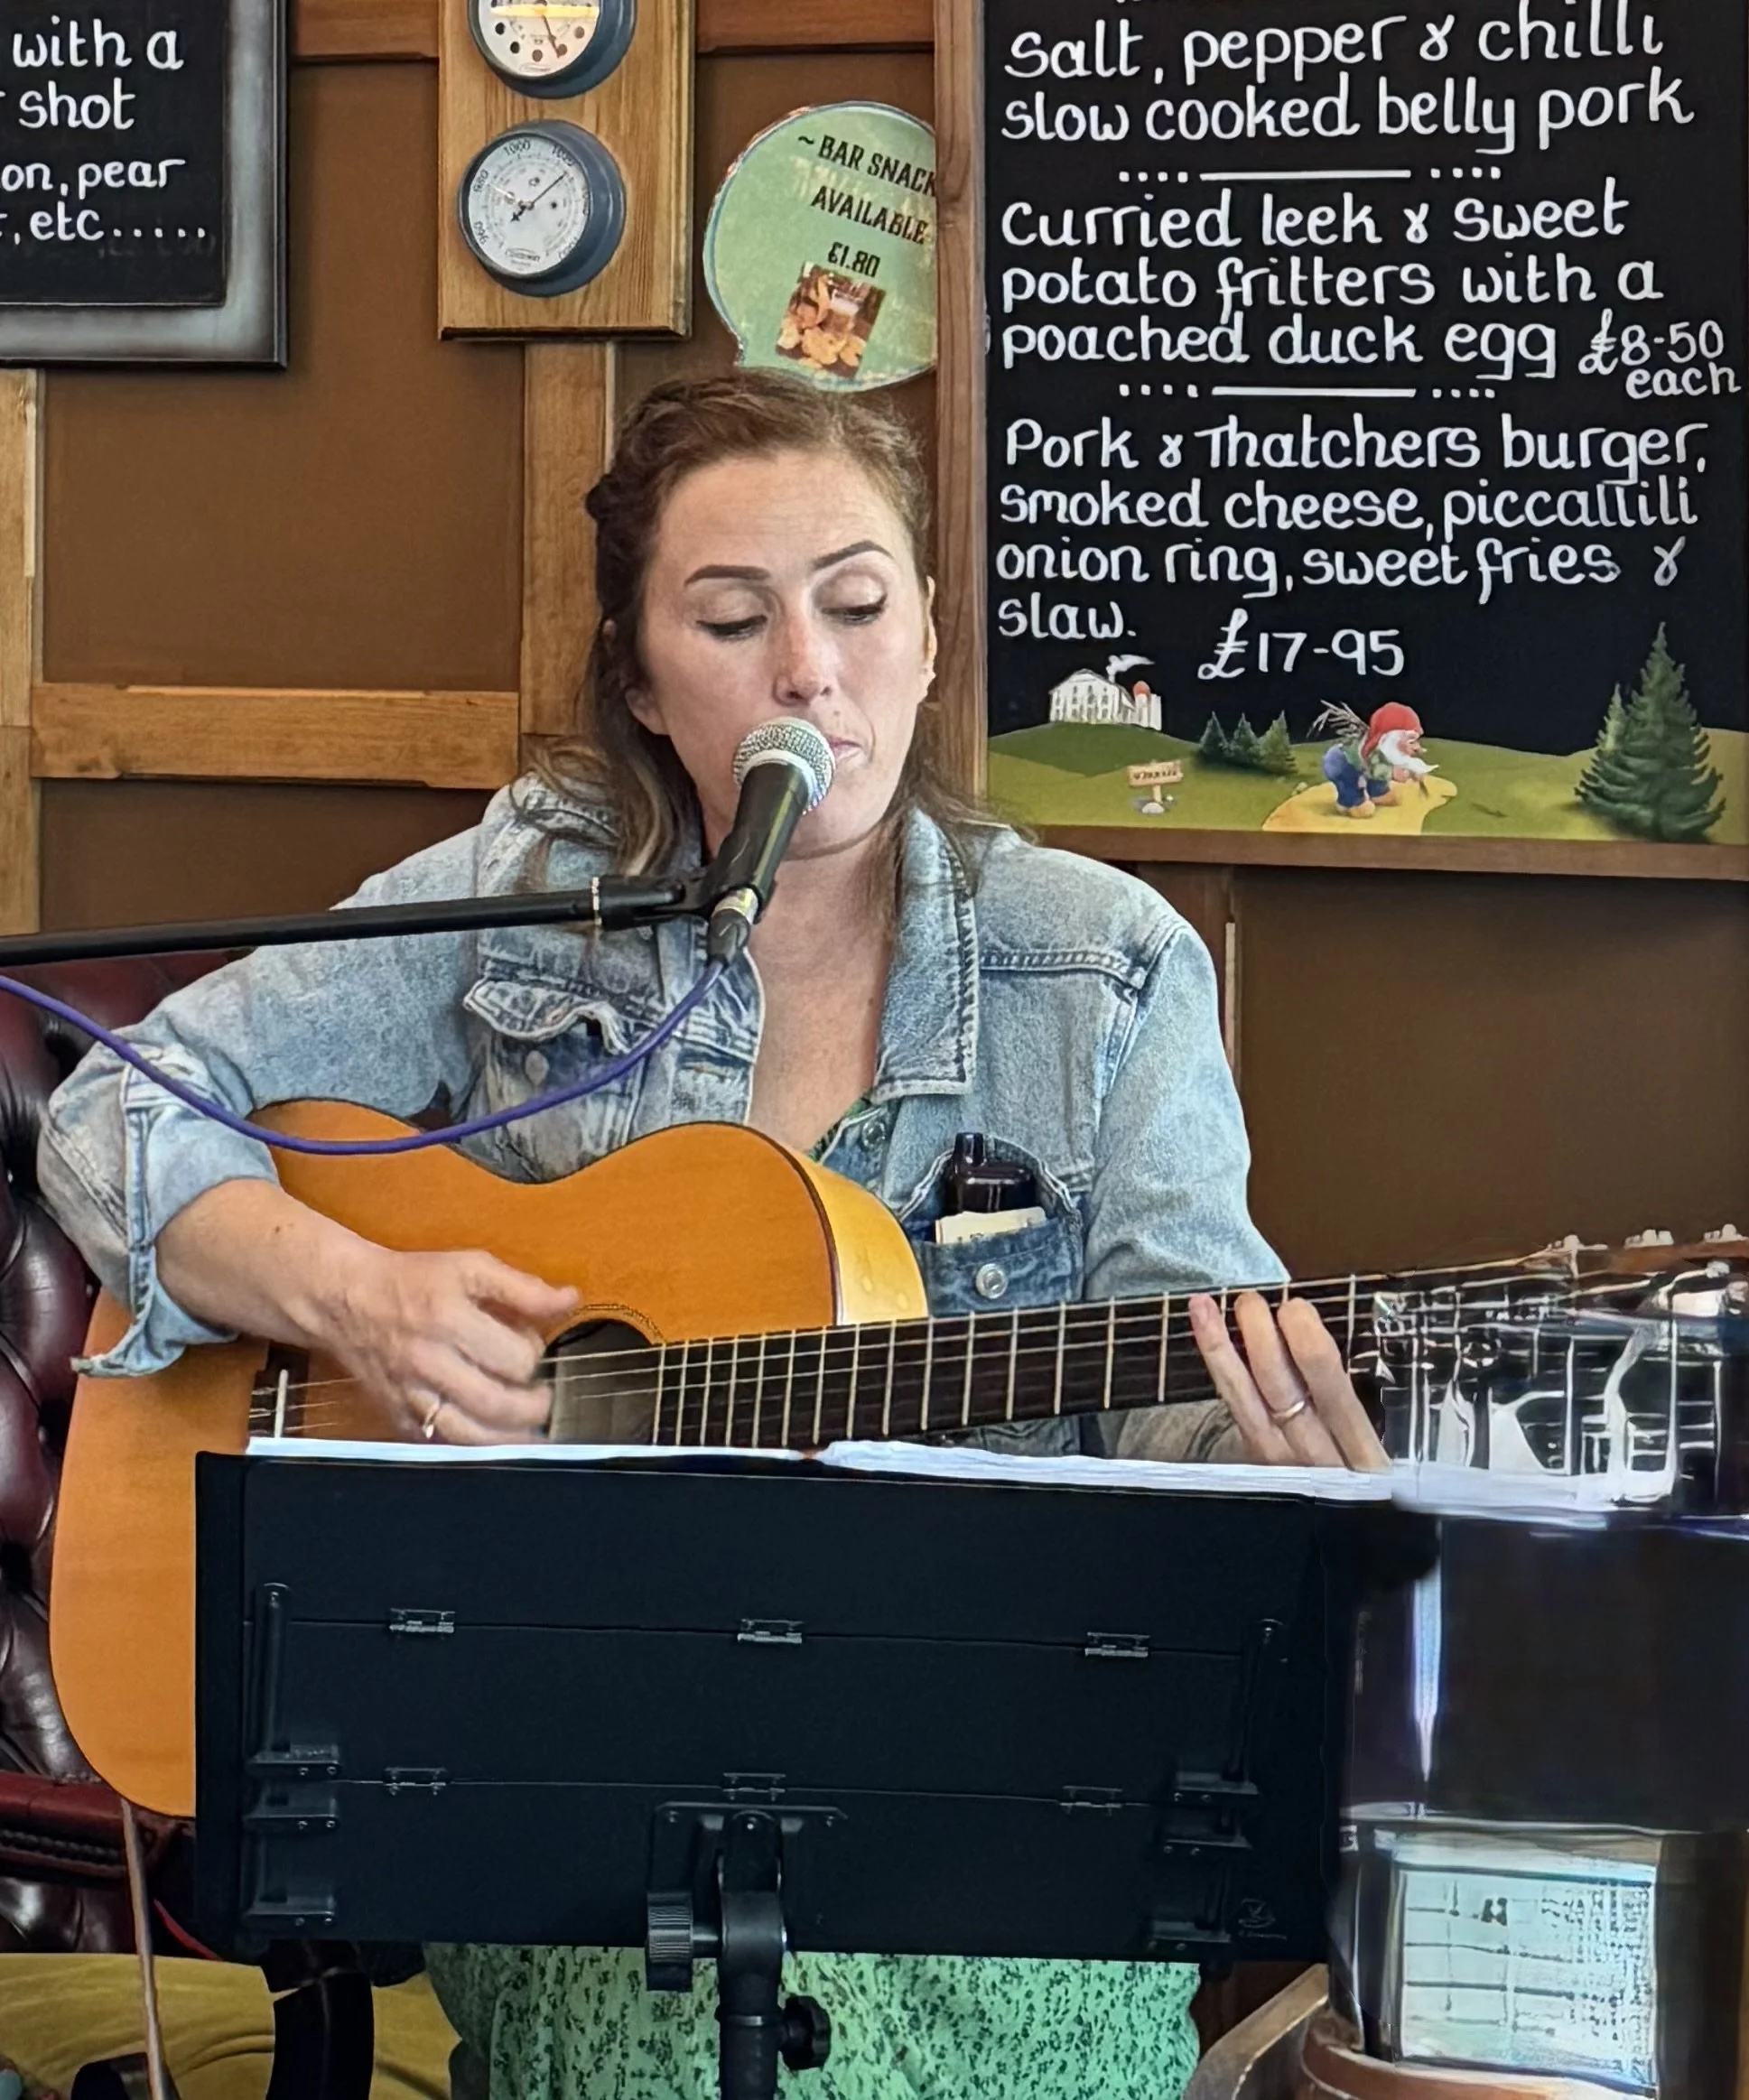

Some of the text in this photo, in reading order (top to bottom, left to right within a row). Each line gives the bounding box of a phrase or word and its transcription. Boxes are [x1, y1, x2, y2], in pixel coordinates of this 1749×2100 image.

[12, 14, 184, 70] with a
[1004, 18, 1164, 85] Salt,
[1183, 15, 1408, 86] pepper
[1478, 0, 1663, 61] chilli
[18, 77, 136, 130] shot
[1000, 65, 1695, 155] slow cooked belly pork
[78, 159, 186, 200] pear
[818, 135, 864, 171] BAR
[811, 185, 928, 245] AVAILABLE
[1001, 187, 1242, 249] Curried
[1261, 191, 1383, 247] leek
[1453, 176, 1630, 242] sweet
[828, 241, 880, 277] £1.80
[1001, 251, 1664, 325] potato fritters with a
[1001, 310, 1251, 369] poached
[1268, 312, 1424, 365] duck
[1444, 322, 1557, 381] egg
[1625, 361, 1742, 400] each
[1006, 415, 1140, 469] Pork
[1194, 412, 1481, 469] Thatchers
[1501, 413, 1707, 486] burger,
[1000, 474, 1698, 544] smoked cheese, piccallili
[996, 535, 1150, 582] onion
[1164, 537, 1294, 599] ring,
[1302, 544, 1469, 587] sweet
[1475, 536, 1622, 605] fries
[998, 591, 1137, 640] slaw.
